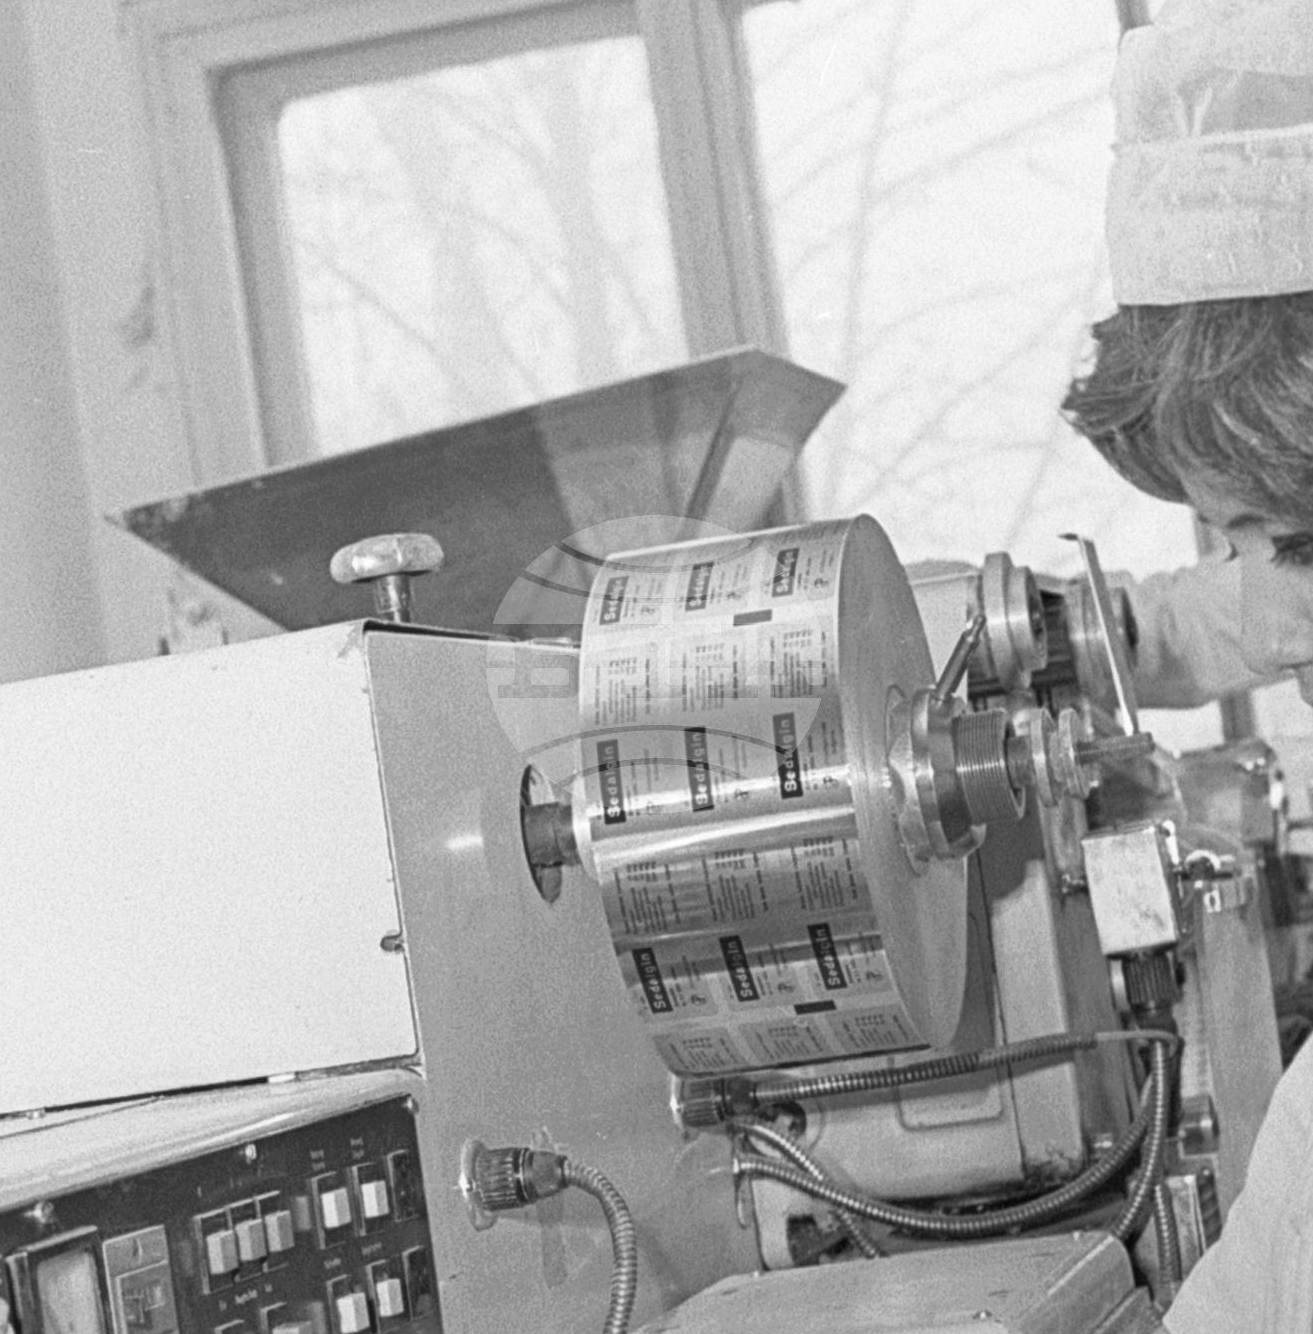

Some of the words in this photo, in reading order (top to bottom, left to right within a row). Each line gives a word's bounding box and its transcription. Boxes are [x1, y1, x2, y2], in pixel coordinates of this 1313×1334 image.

[602, 744, 623, 818] Sedalgin
[639, 952, 668, 1011] Sedalgin
[726, 939, 755, 1000] Sedalgin
